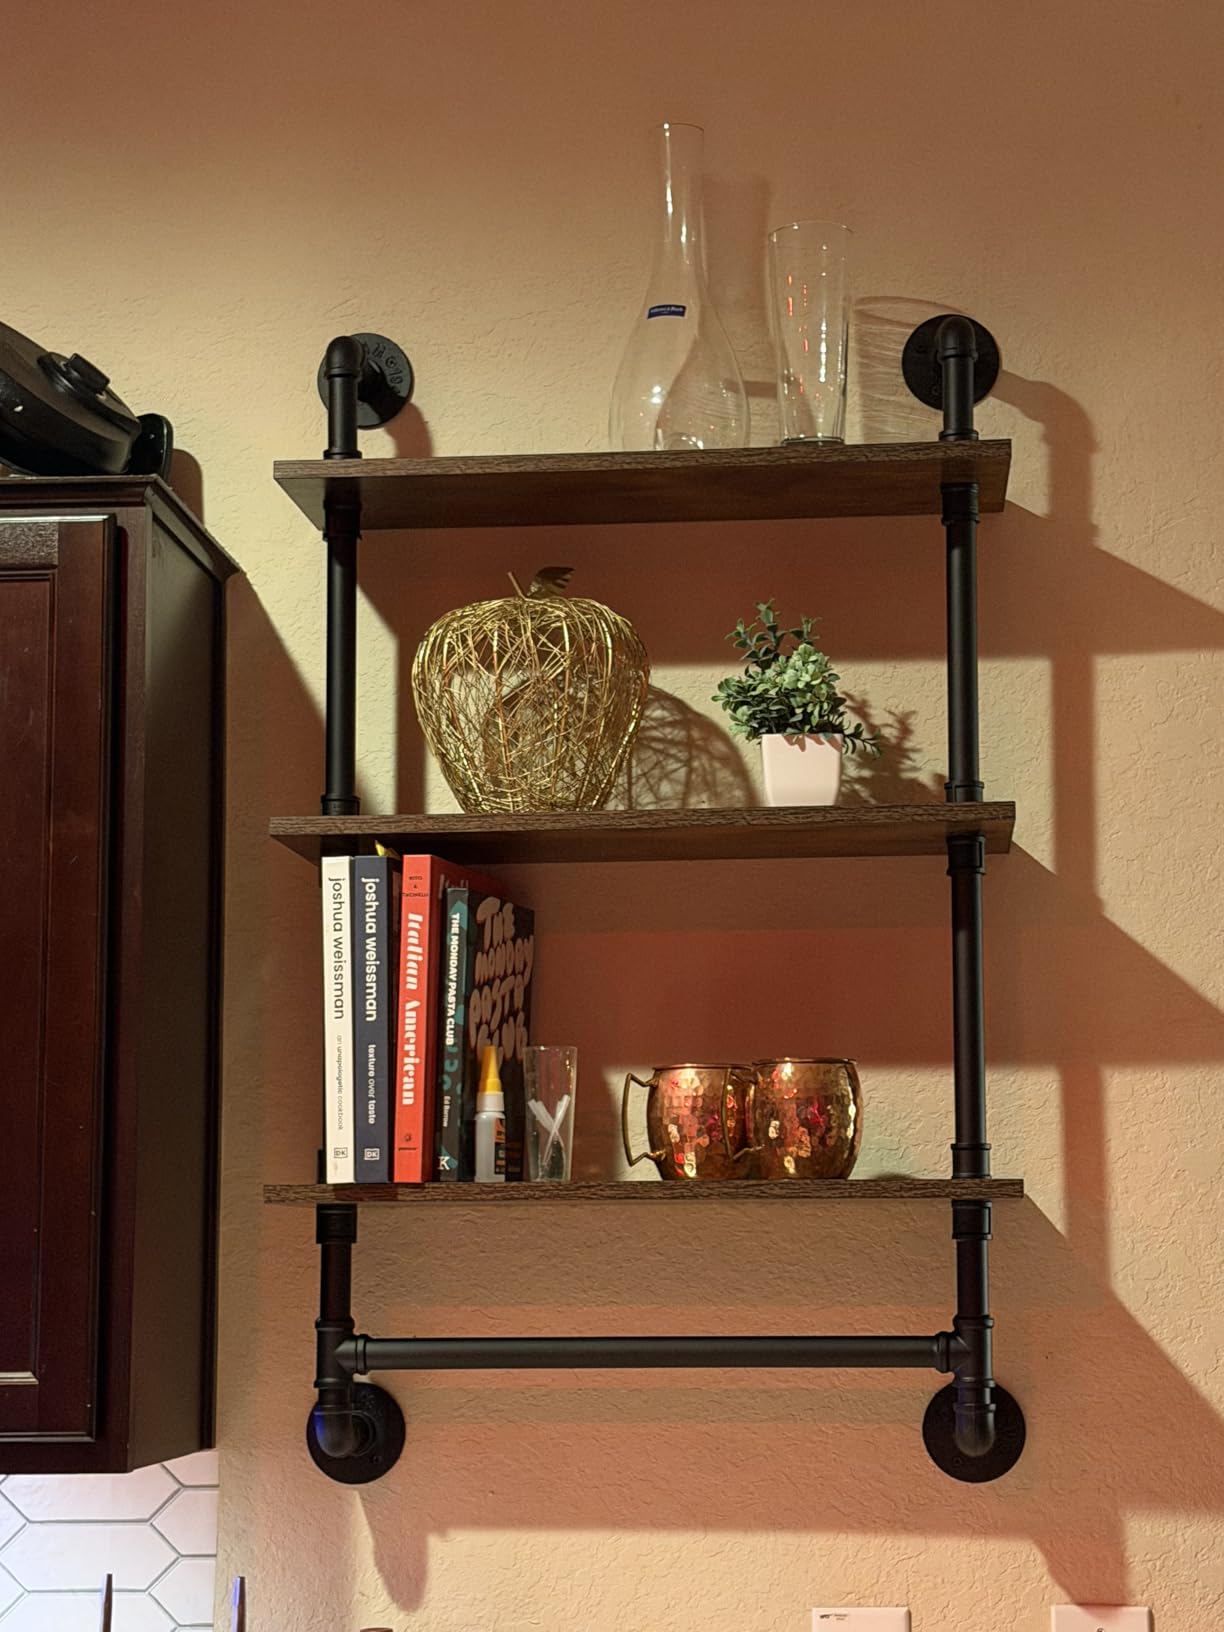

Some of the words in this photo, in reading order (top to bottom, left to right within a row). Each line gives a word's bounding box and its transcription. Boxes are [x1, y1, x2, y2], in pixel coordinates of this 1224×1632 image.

[328, 877, 345, 932] joshua
[361, 877, 380, 934] joshua
[451, 912, 460, 934] THE
[406, 913, 423, 990] Italian
[449, 935, 459, 981] MONDAY
[333, 936, 347, 1020] weissman
[365, 937, 381, 1022] weissman
[446, 982, 457, 1016] PASTA
[402, 1000, 421, 1105] American
[445, 1018, 456, 1046] CLUB
[368, 1044, 376, 1077] texture
[368, 1099, 376, 1124] taste
[438, 1156, 450, 1170] K
